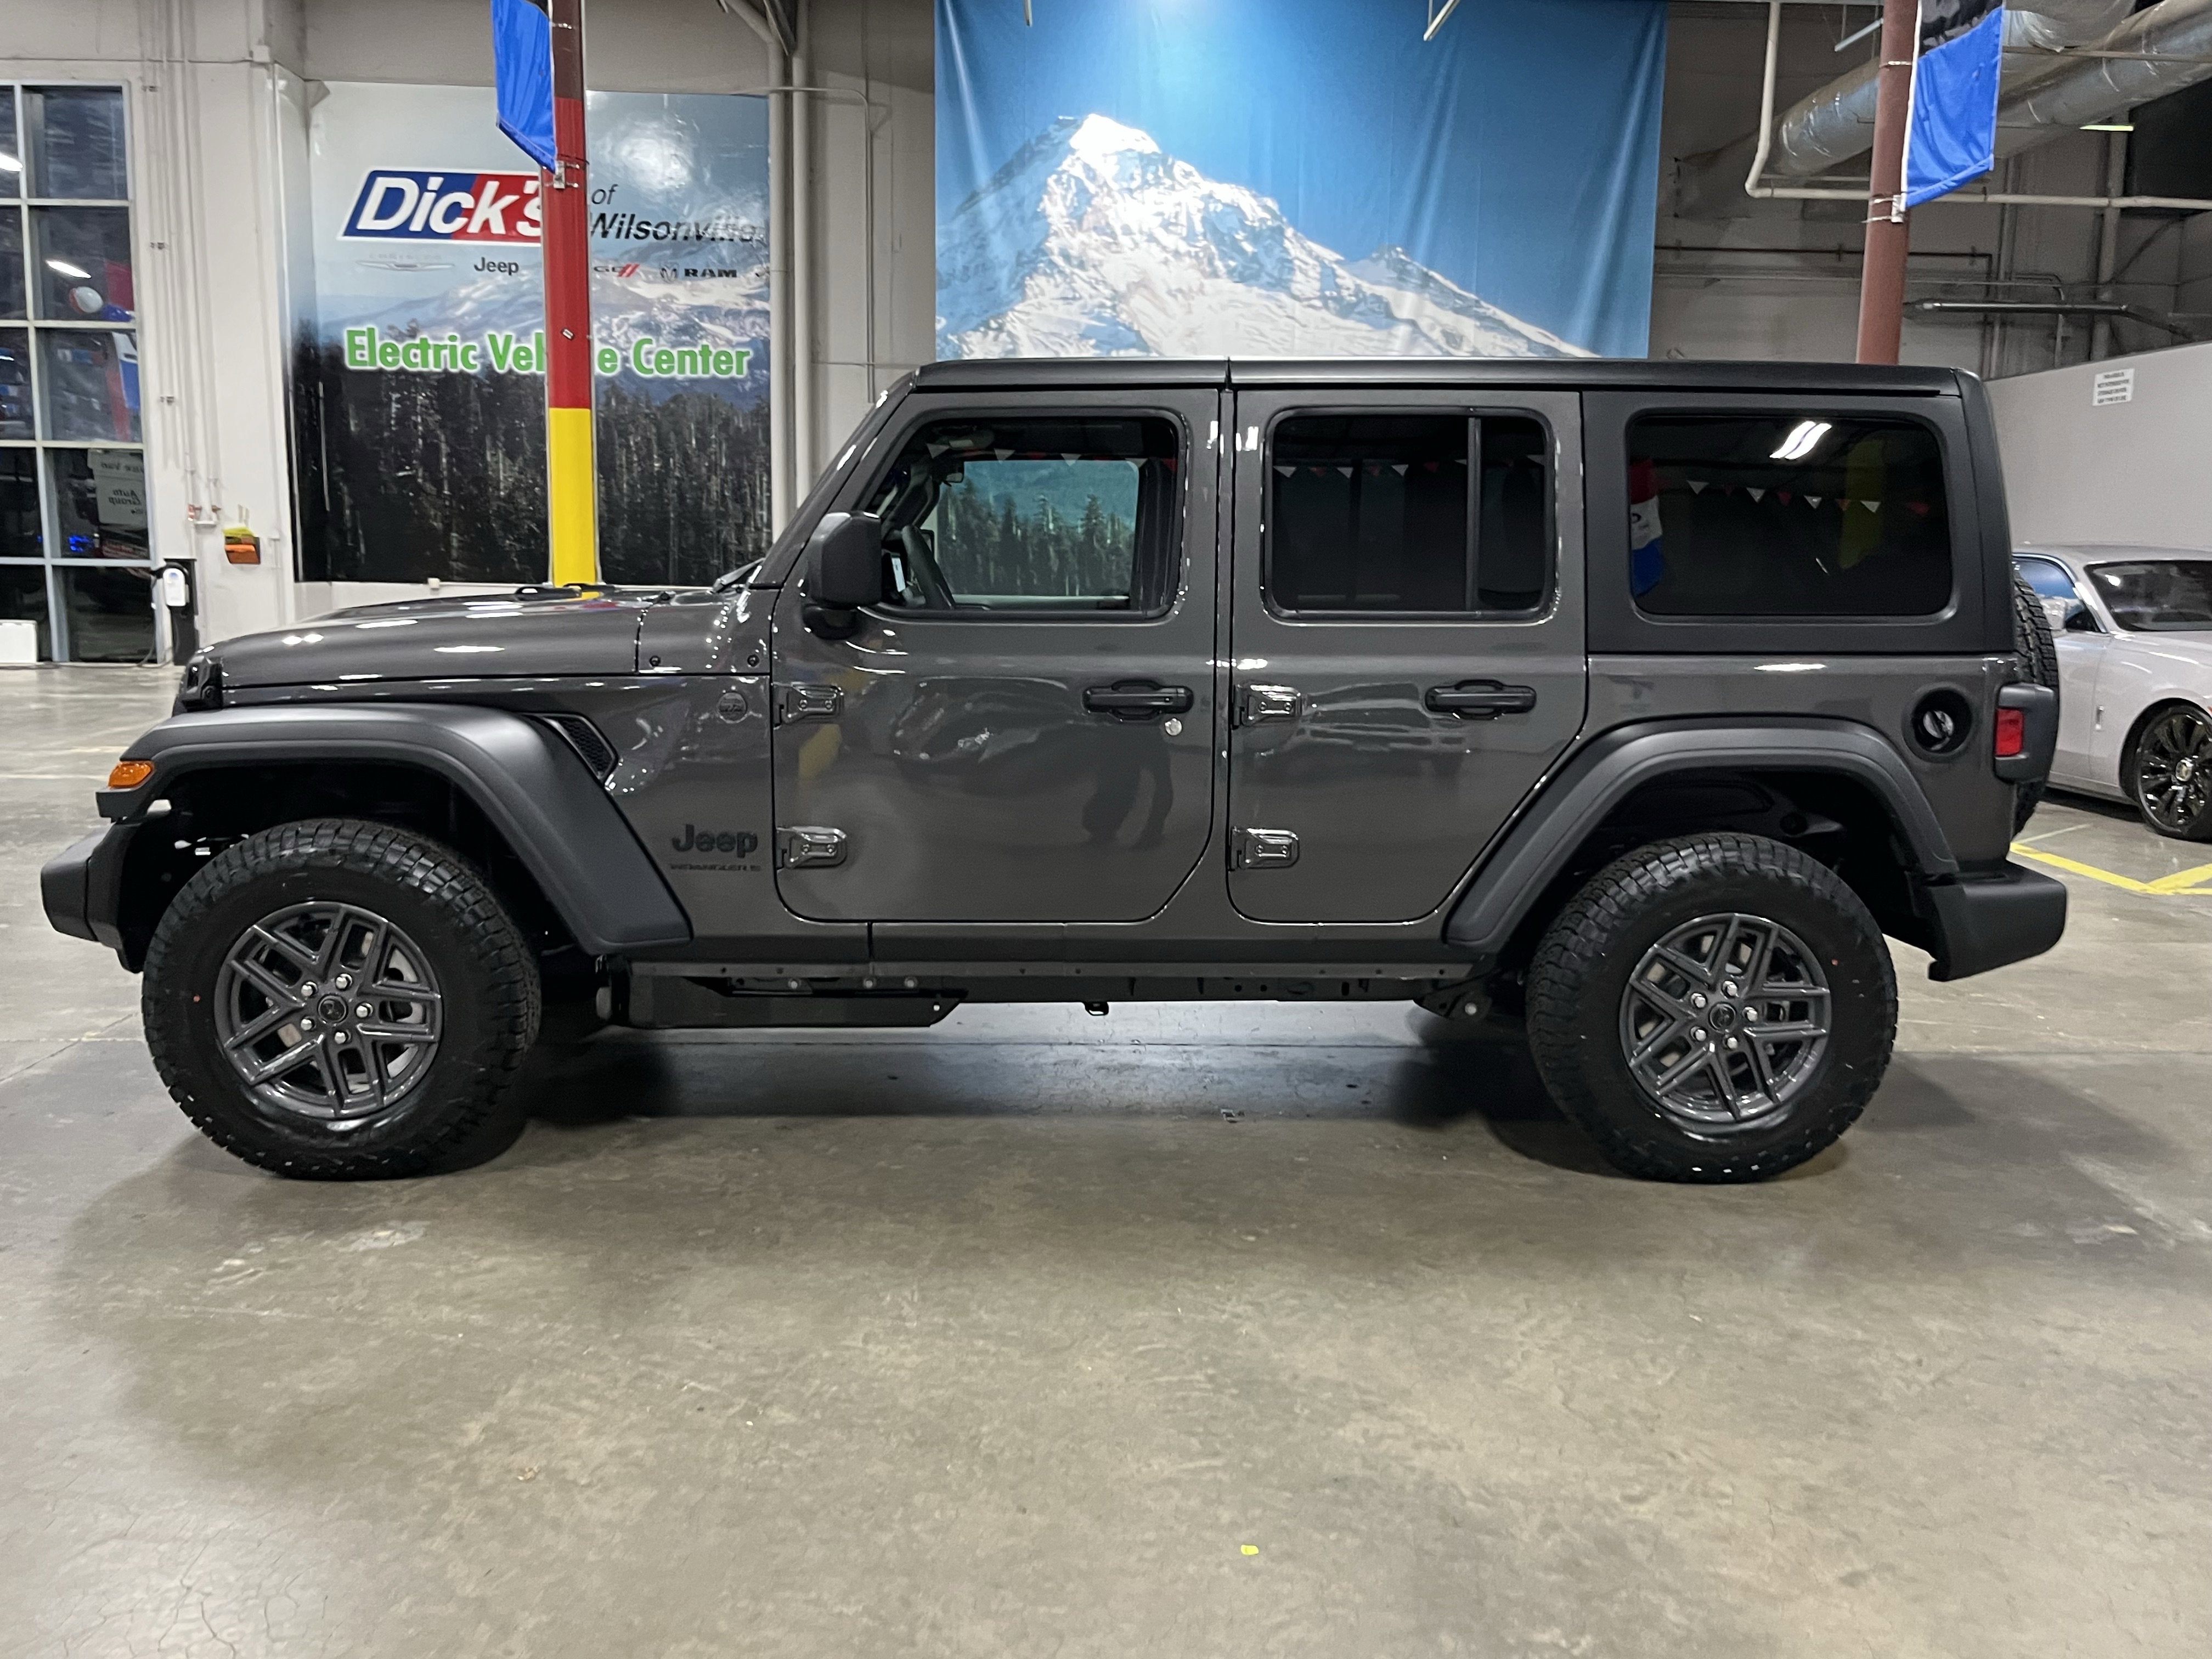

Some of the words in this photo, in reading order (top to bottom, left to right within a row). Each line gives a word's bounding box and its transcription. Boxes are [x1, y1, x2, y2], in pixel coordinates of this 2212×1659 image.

[591, 184, 618, 205] of
[473, 257, 520, 275] Jeep
[684, 268, 737, 278] RAM
[346, 327, 478, 370] Electric
[633, 338, 751, 376] Center
[671, 823, 758, 859] Jeep
